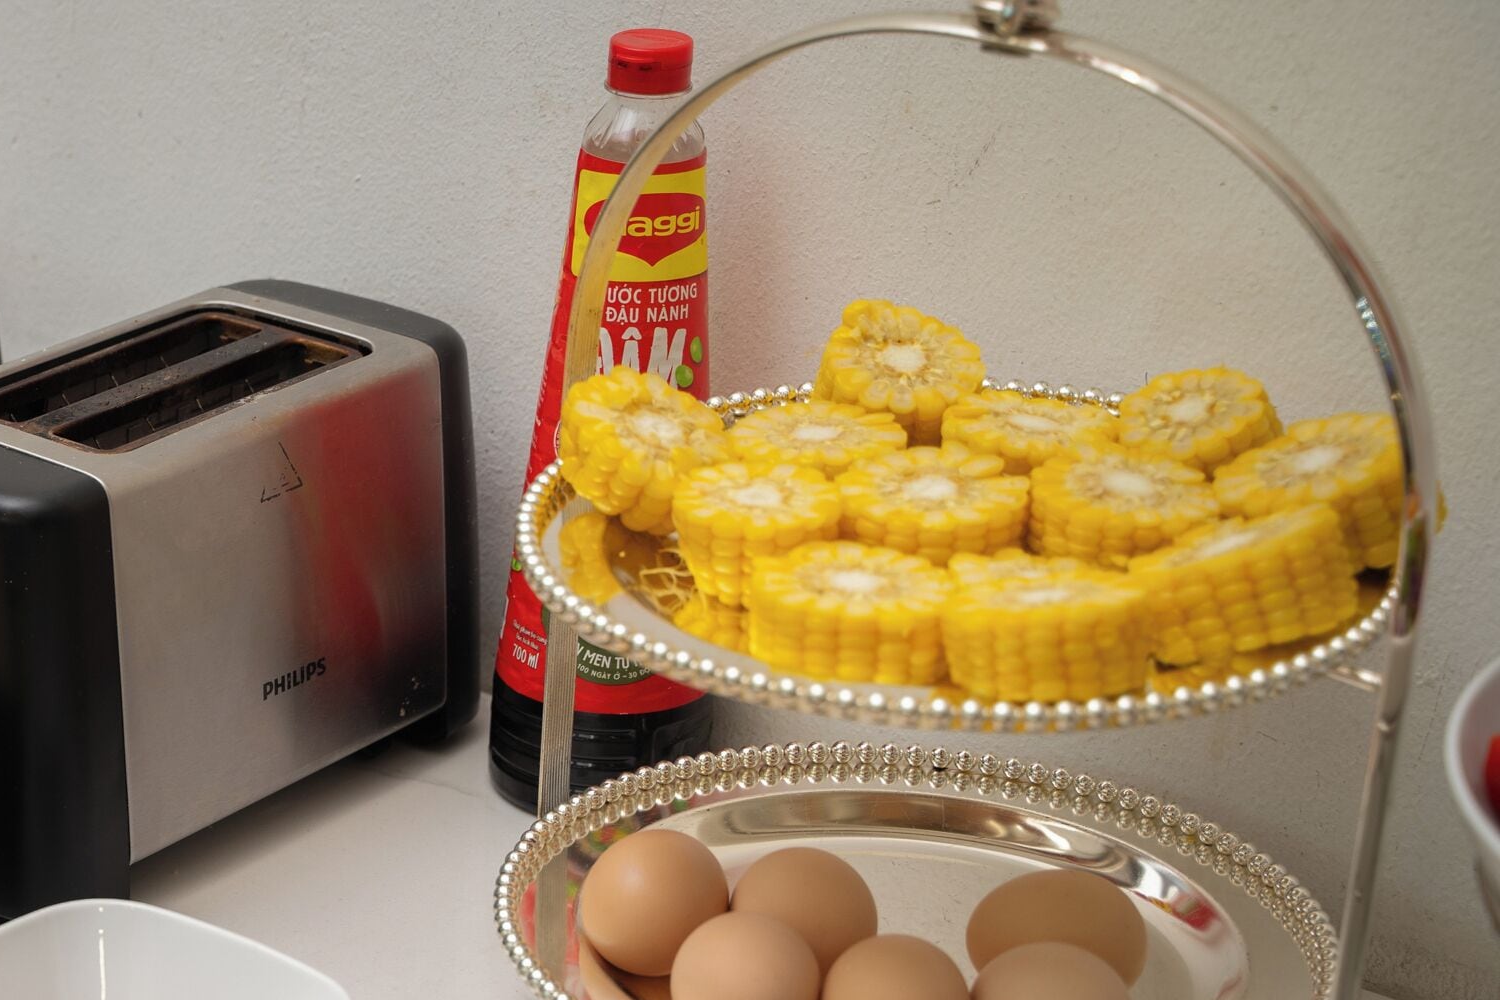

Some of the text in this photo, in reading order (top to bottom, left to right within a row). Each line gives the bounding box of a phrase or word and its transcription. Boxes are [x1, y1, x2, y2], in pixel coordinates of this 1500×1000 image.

[621, 206, 700, 237] aggi
[607, 282, 698, 304] ƯỚC TƯƠNG
[605, 303, 689, 325] ĐẬU NÀNH
[512, 643, 540, 669] 700 ml
[582, 650, 612, 669] MEN
[262, 656, 326, 701] PHILIPS
